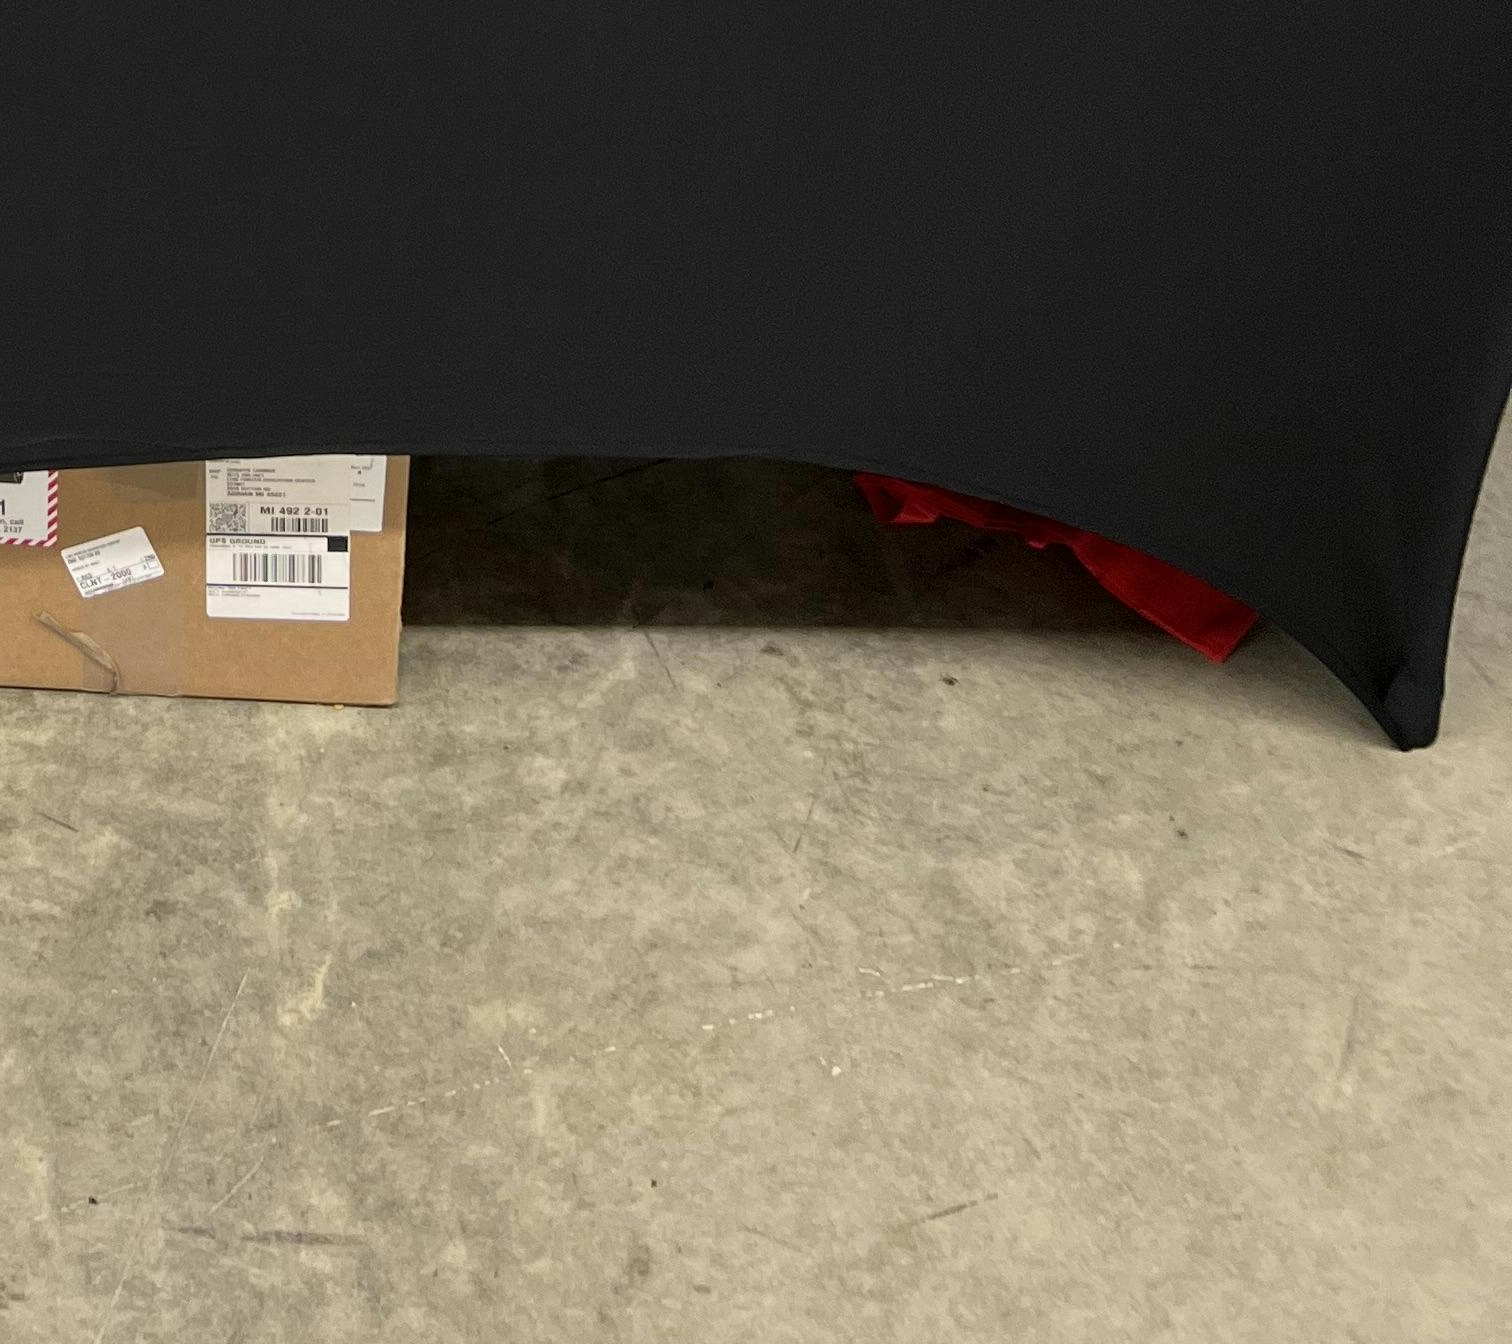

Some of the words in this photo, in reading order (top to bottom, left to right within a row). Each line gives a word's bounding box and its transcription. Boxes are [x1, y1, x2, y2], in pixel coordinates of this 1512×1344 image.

[260, 507, 275, 515] MI
[279, 507, 299, 515] 492
[304, 507, 328, 516] 2-01
[10, 518, 25, 526] call
